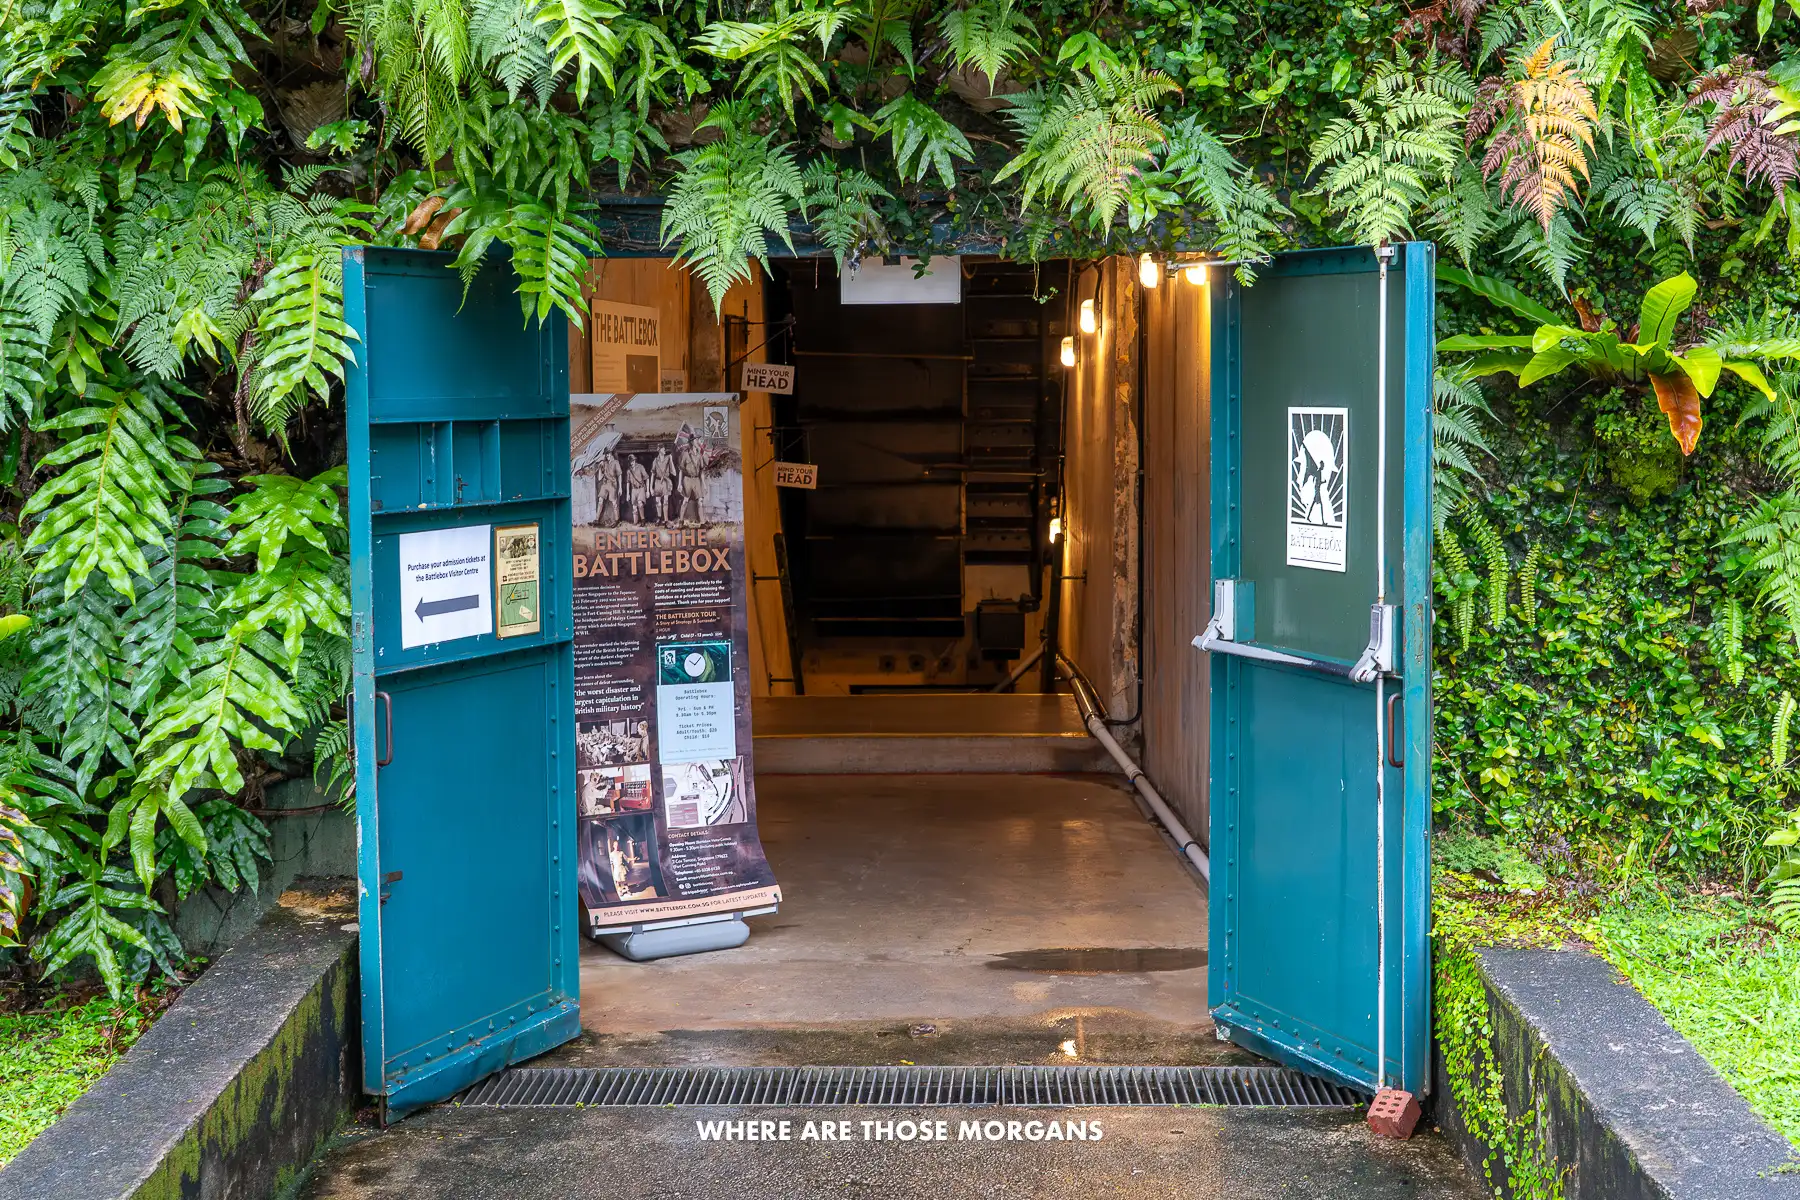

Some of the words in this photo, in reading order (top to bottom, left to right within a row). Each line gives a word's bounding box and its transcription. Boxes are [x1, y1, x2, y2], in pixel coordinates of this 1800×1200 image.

[595, 313, 611, 343] THE
[614, 315, 658, 346] BATTLEBOX
[747, 375, 788, 389] HEAD
[581, 424, 597, 440] GUIDED
[596, 411, 611, 424] TOURS
[611, 400, 622, 412] ONLY
[777, 473, 812, 484] HEAD
[595, 531, 660, 550] ENTER
[667, 529, 707, 547] THE
[1291, 535, 1342, 552] BATTLEBOX
[408, 560, 430, 571] Purchase
[431, 560, 442, 570] your
[442, 557, 465, 567] admission
[466, 556, 480, 564] tickets
[573, 548, 732, 578] BATTLEBOX
[416, 573, 425, 582] the
[425, 572, 448, 581] Battlebox
[449, 569, 463, 578] Visitor
[464, 567, 479, 575] Centre
[668, 612, 700, 620] BATTLEBOX
[596, 696, 631, 705] capitulation
[596, 705, 619, 713] military
[639, 902, 710, 914] WWW.BATTLEBOX.COM.SG
[721, 897, 742, 905] LATEST
